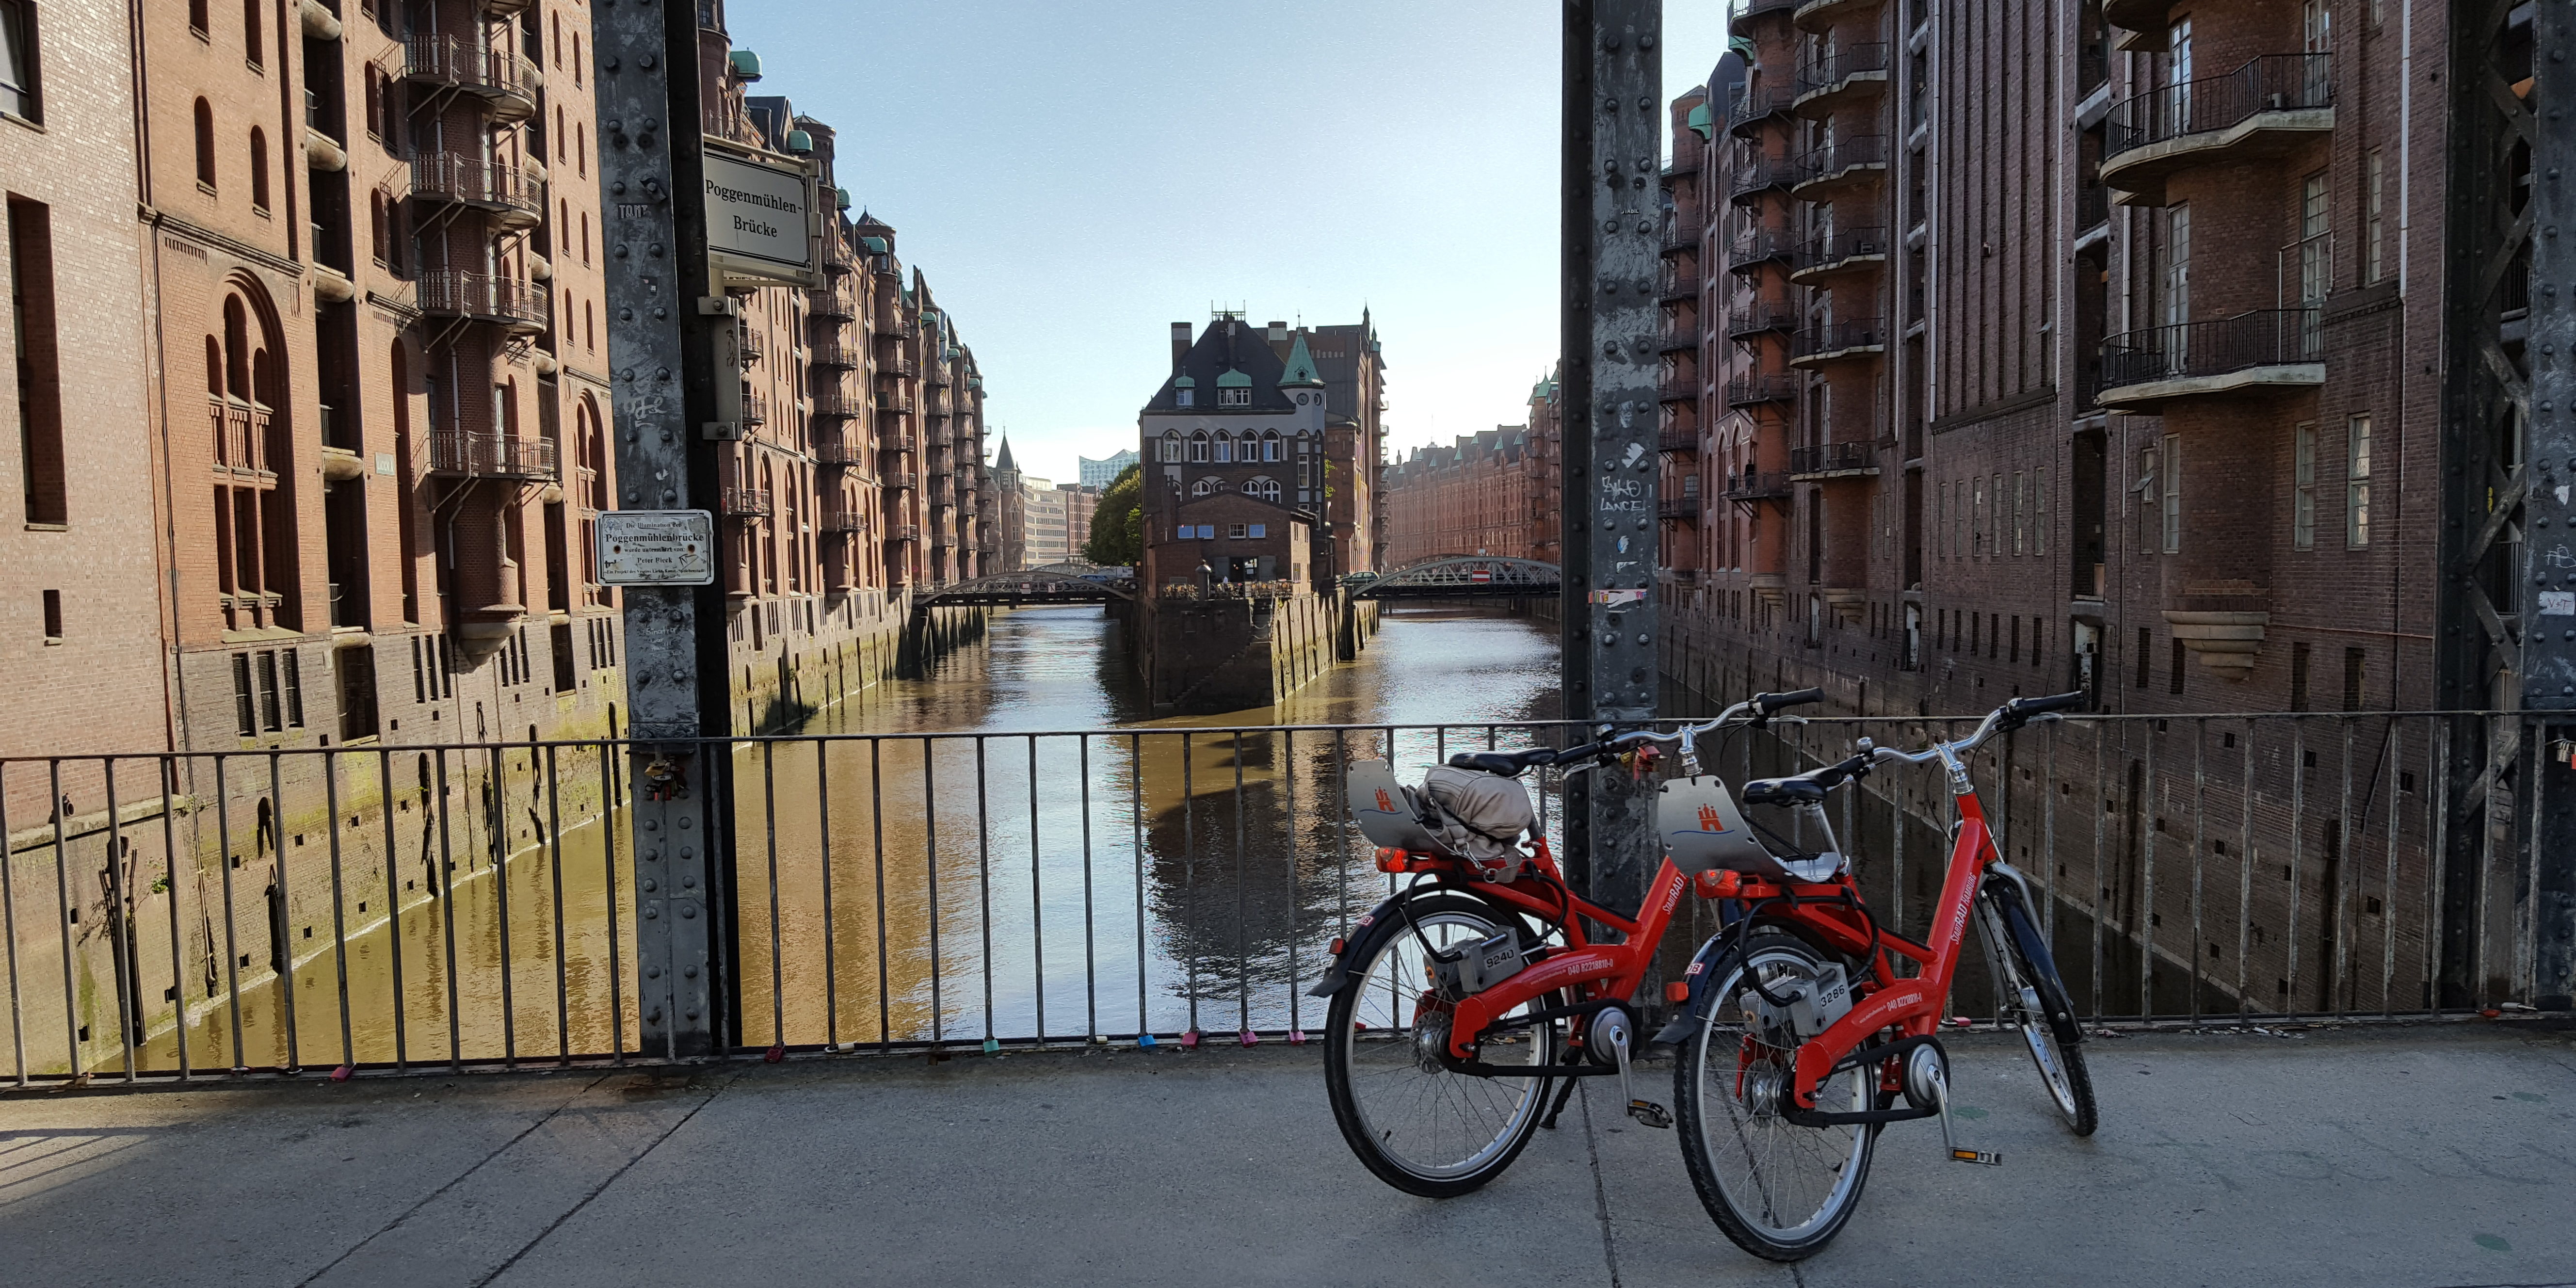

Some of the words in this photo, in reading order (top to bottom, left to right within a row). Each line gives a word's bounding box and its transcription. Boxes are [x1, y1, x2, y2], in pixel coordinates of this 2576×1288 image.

[706, 179, 803, 213] Poggenmühlen-
[733, 215, 777, 237] Brücke
[606, 533, 704, 544] Poggenmühlenbrücke
[1567, 965, 1580, 976] 040
[1821, 984, 1845, 1007] 3286
[1886, 996, 1897, 1012] 040
